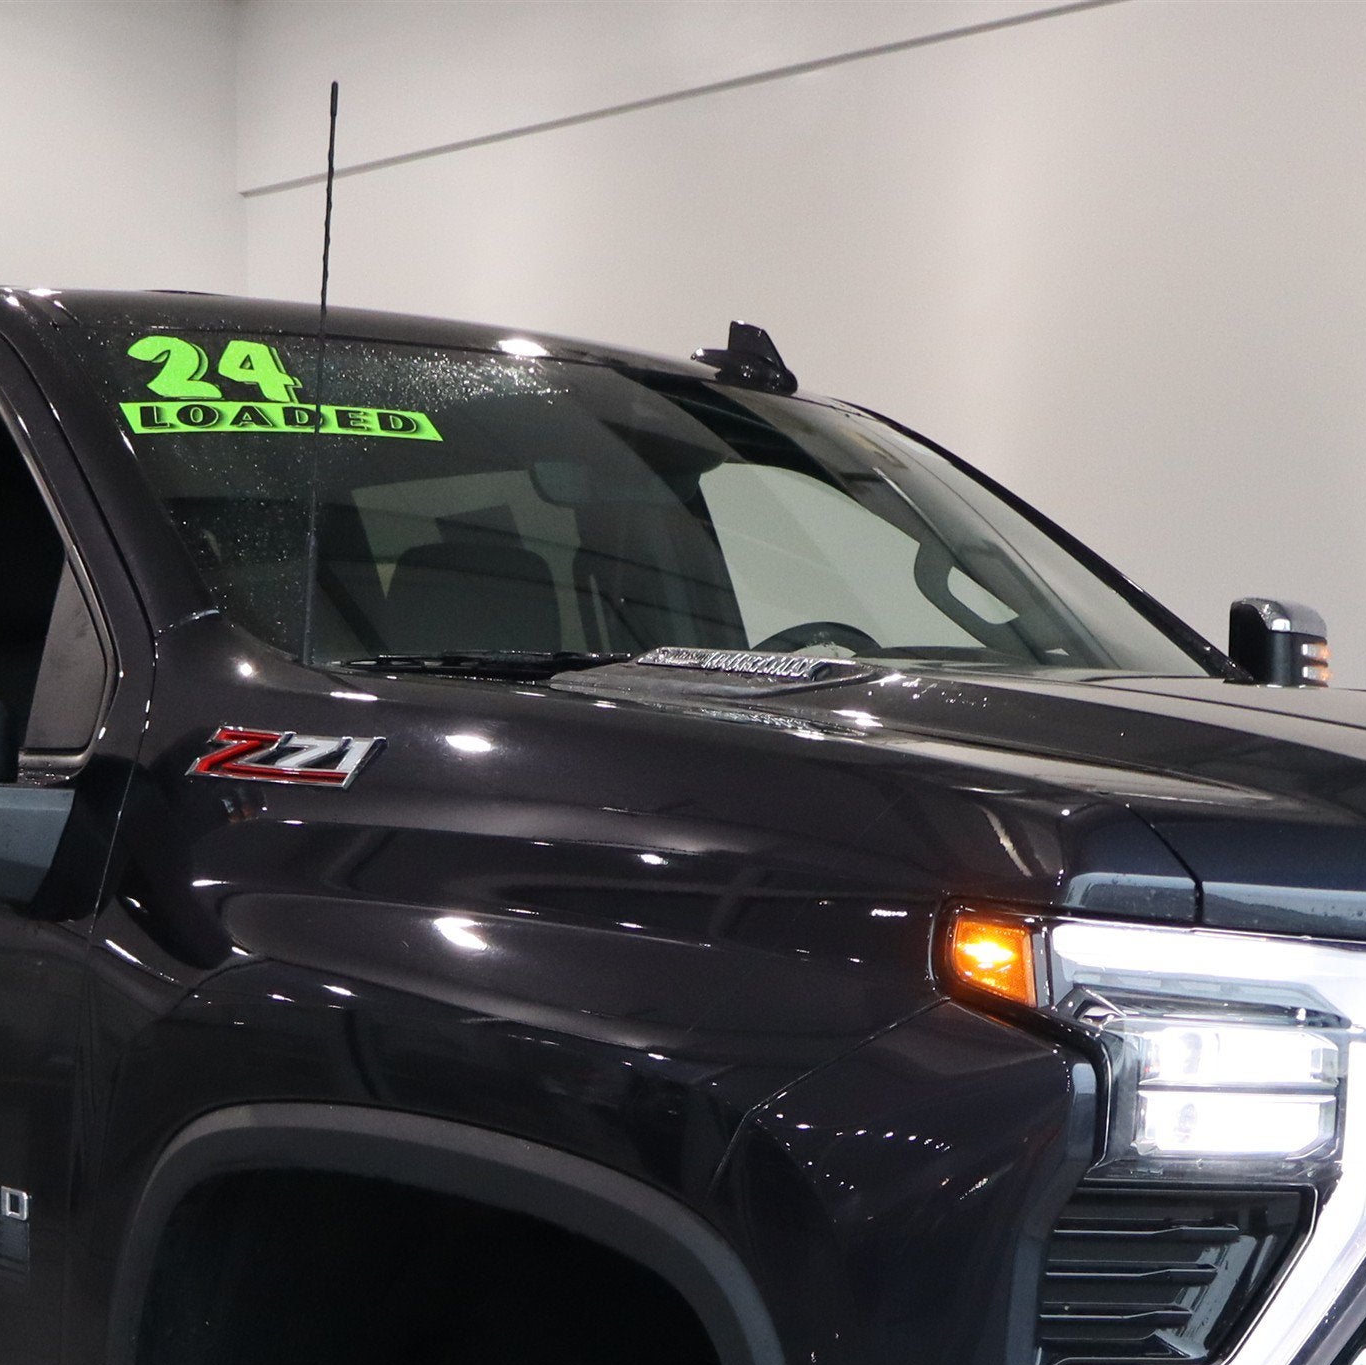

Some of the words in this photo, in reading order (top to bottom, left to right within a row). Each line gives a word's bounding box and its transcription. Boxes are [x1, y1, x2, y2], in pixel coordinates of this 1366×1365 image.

[127, 335, 302, 403] 24
[137, 403, 419, 434] LOADED
[185, 726, 386, 789] Z71
